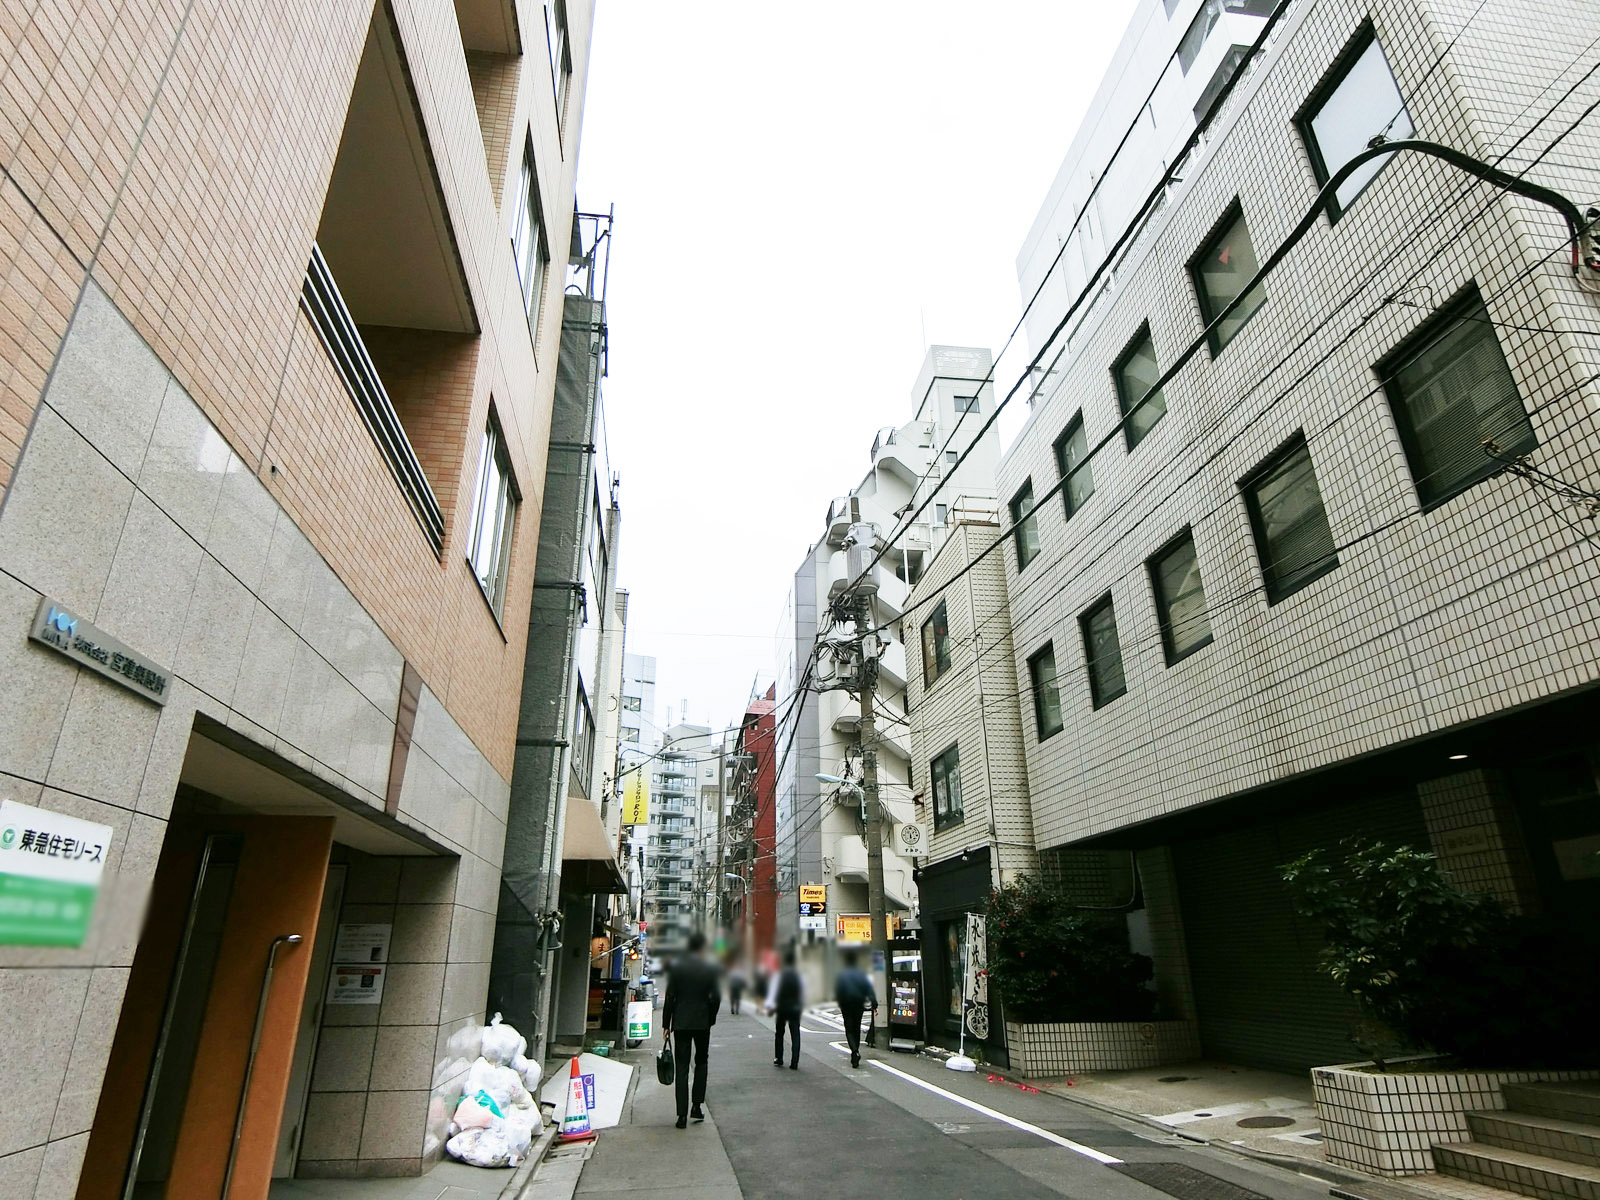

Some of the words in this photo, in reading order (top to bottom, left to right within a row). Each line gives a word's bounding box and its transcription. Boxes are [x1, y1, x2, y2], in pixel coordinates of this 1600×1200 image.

[19, 828, 103, 864] 東急住宅リース
